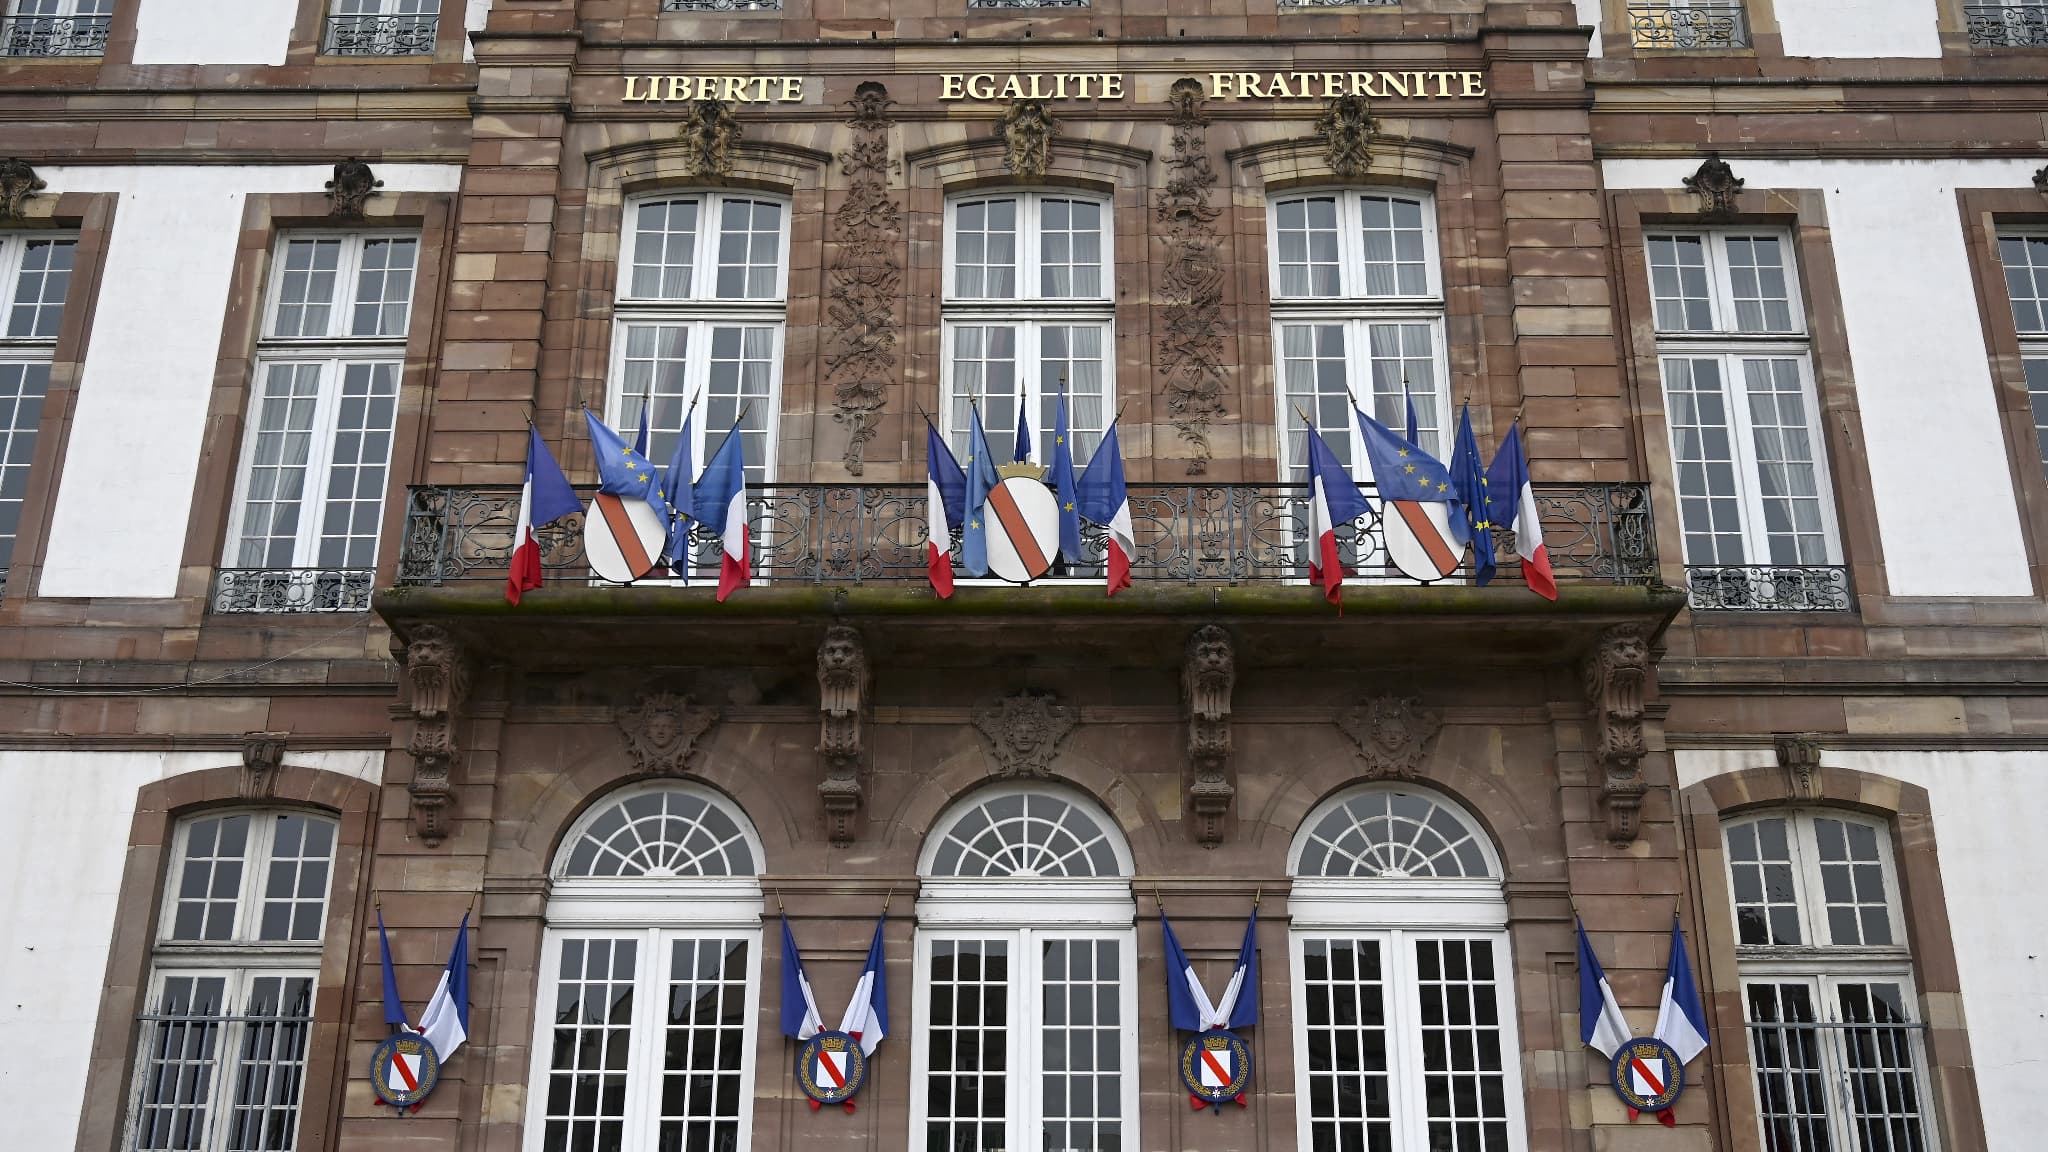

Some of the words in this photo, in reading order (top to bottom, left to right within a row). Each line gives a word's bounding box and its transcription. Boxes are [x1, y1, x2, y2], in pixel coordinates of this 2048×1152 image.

[621, 76, 804, 101] LIBERTE
[939, 73, 1124, 99] EGALITE
[1209, 71, 1487, 97] FRATERNITE
